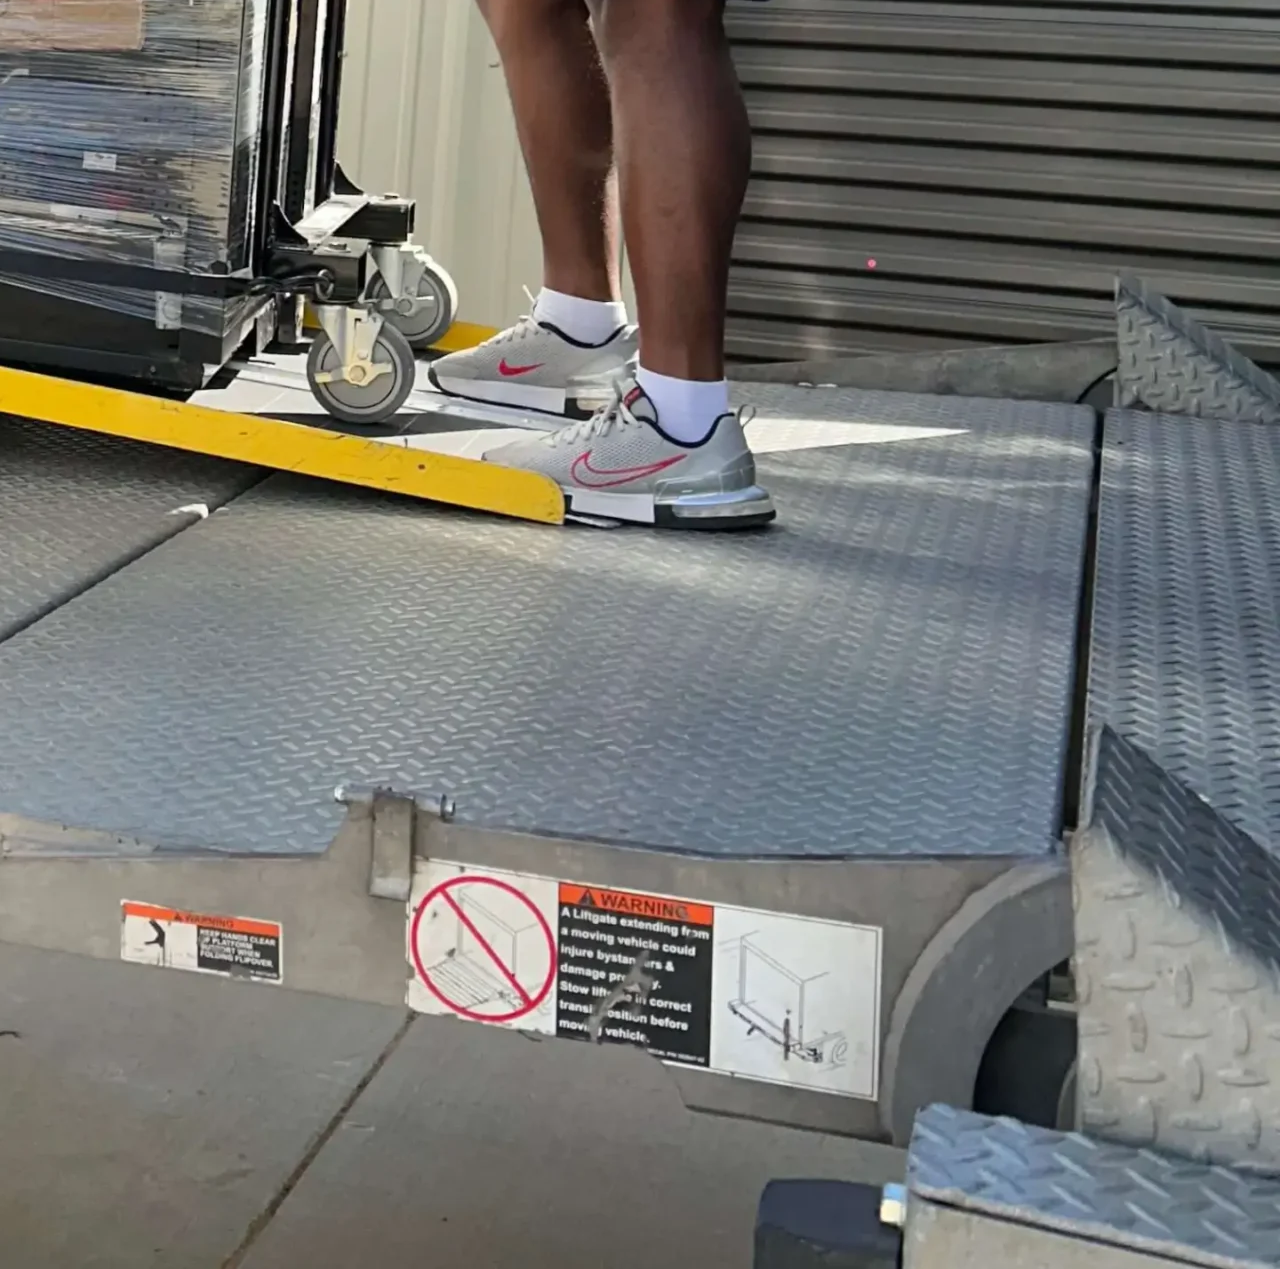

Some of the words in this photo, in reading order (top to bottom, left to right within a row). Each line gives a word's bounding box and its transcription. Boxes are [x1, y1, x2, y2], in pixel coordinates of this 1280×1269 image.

[600, 892, 690, 919] WARNING
[561, 907, 571, 918] A
[573, 908, 618, 926] Liftgate
[620, 916, 679, 938] extending
[249, 936, 276, 946] CLEAR
[560, 927, 568, 936] a
[571, 928, 615, 945] moving
[617, 936, 660, 951] vehicle
[662, 941, 696, 957] could
[560, 944, 594, 960] injure
[665, 961, 675, 972] &
[560, 962, 606, 980] damage
[559, 980, 590, 995] Stow
[649, 996, 692, 1013] correct
[605, 1027, 650, 1043] vehicle.
[650, 1016, 689, 1031] before
